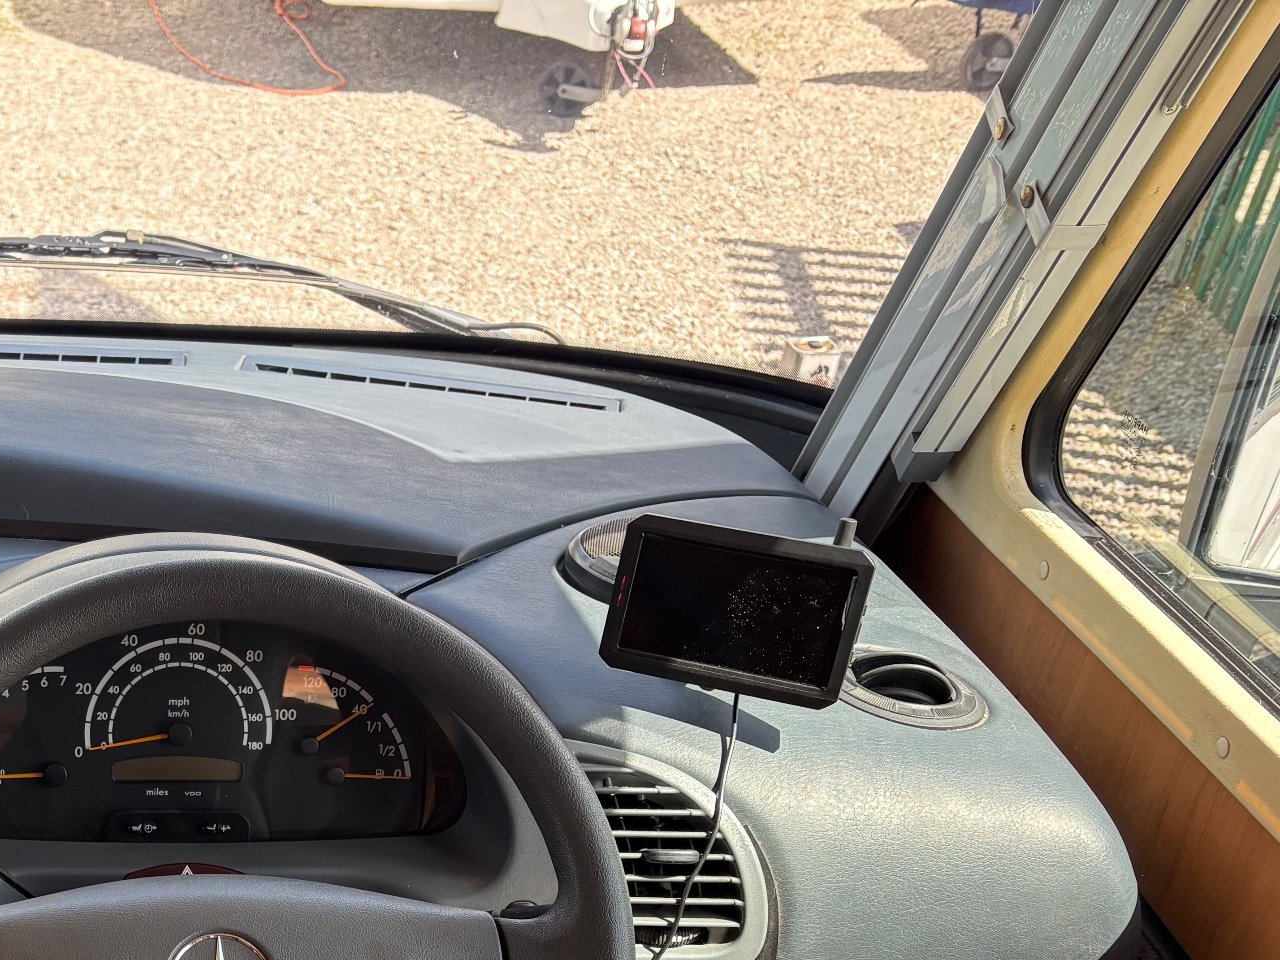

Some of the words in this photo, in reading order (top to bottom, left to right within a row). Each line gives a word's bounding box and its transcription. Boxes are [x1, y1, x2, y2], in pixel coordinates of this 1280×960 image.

[187, 623, 205, 636] 60
[120, 634, 138, 647] 40
[158, 652, 170, 661] 80
[189, 652, 204, 661] 100
[245, 650, 263, 662] 80
[130, 664, 142, 673] 60
[217, 664, 232, 672] 120
[21, 680, 30, 691] 5
[40, 676, 49, 688] 6
[60, 675, 67, 686] 7
[303, 677, 322, 688] 120
[1, 688, 10, 698] 4
[75, 683, 92, 695] 20
[107, 685, 120, 694] 40
[238, 686, 254, 695] 140
[331, 687, 347, 698] 80
[168, 696, 190, 706] mph
[167, 709, 190, 718] km/h
[275, 708, 297, 720] 100
[351, 704, 368, 715] 40
[96, 712, 108, 720] 20
[247, 713, 263, 722] 160
[366, 720, 381, 734] 1/1
[247, 741, 263, 750] 180
[379, 744, 396, 757] 1/2
[74, 746, 83, 758] 0
[146, 788, 169, 796] miles
